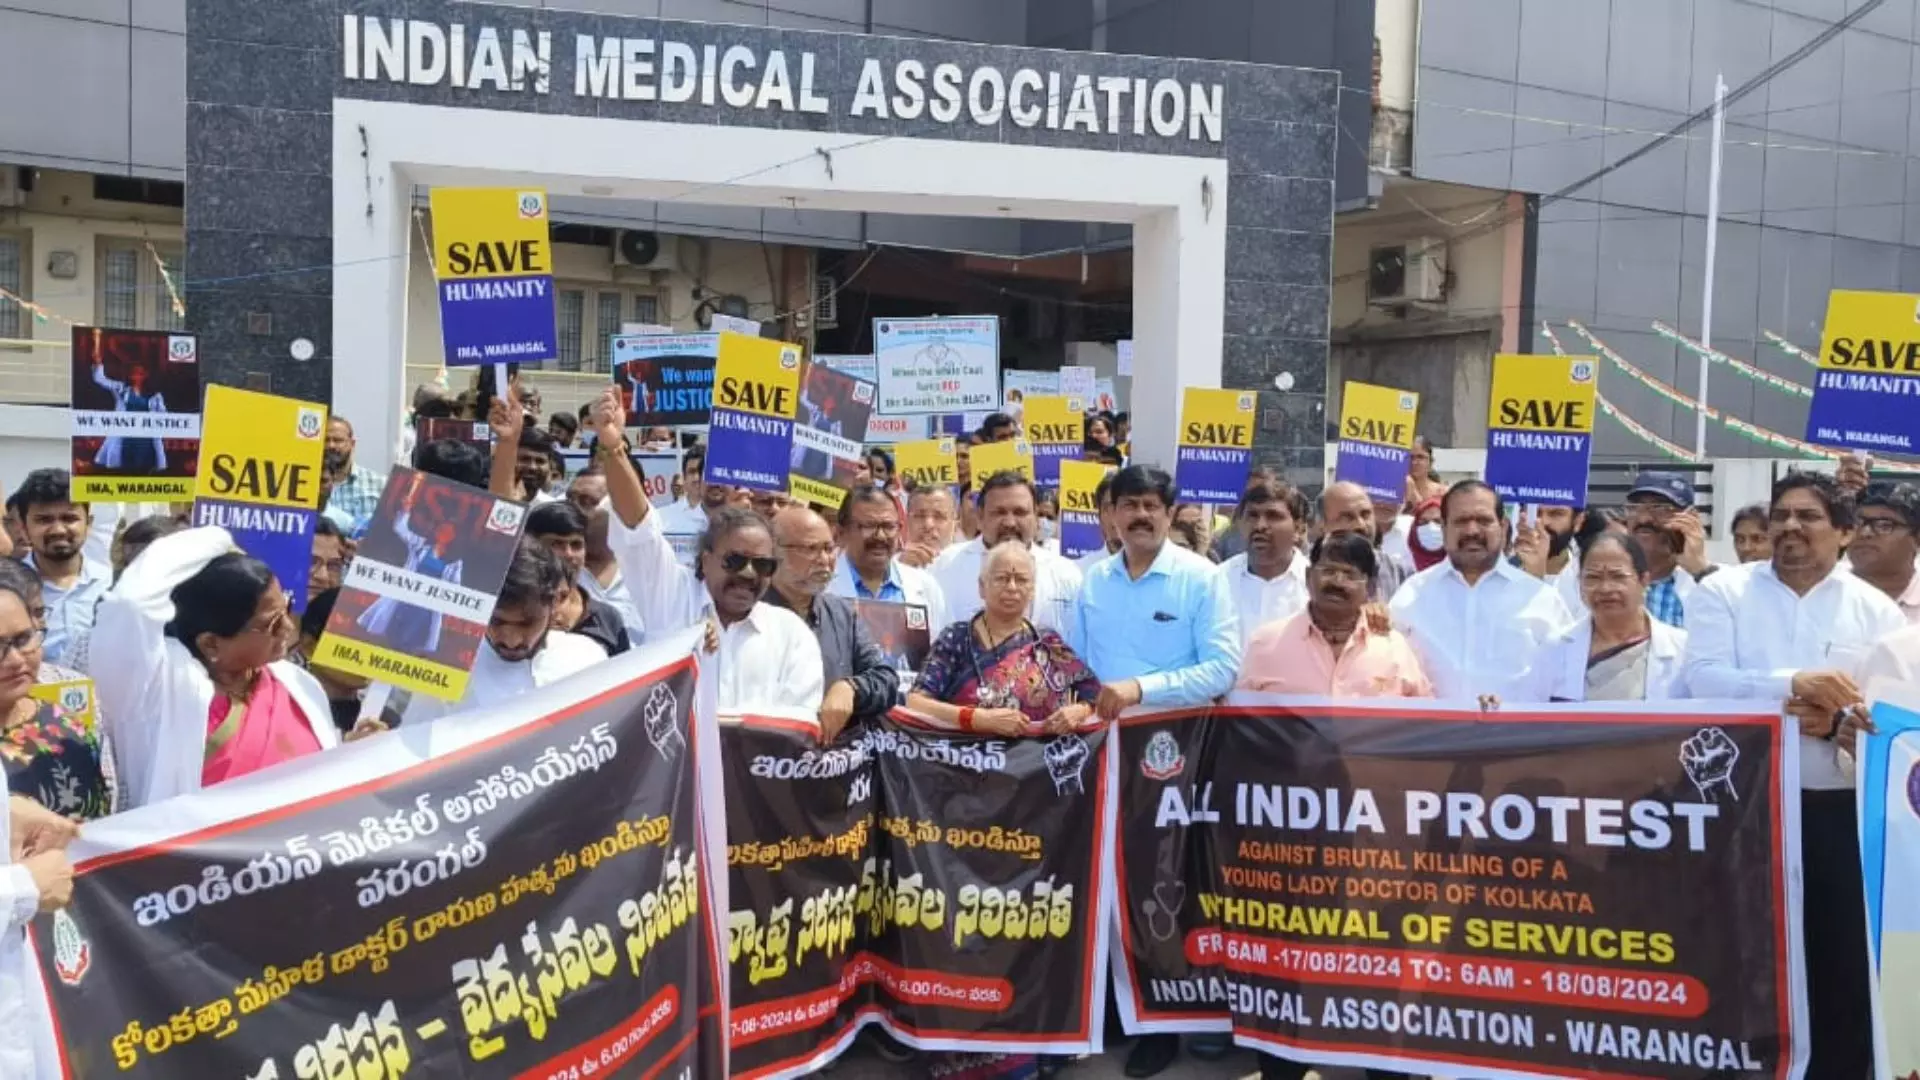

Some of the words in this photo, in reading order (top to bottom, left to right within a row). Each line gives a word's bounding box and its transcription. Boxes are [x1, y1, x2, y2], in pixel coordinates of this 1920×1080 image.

[343, 14, 552, 95] INDIAN
[574, 33, 829, 114] MEDICAL
[850, 58, 1223, 142] ASSOCIATION
[448, 240, 543, 276] SAVE
[445, 279, 546, 301] HUMANITY
[457, 346, 482, 359] IMA,
[484, 341, 547, 356] WARANGAL
[1829, 337, 1920, 371] SAVE
[660, 366, 682, 384] We
[685, 366, 716, 383] wan
[719, 376, 791, 415] SAVE
[76, 416, 95, 426] WE
[100, 416, 137, 428] WANT
[142, 417, 192, 429] JUSTICE
[713, 411, 790, 437] HUMANITY
[1499, 397, 1585, 429] SAVE
[1028, 423, 1078, 441] SAVE
[1187, 421, 1246, 446] SAVE
[1346, 416, 1407, 446] SAVE
[1492, 431, 1585, 452] HUMANITY
[1817, 427, 1842, 442] IMA,
[1845, 430, 1912, 448] WARANGAL
[1180, 448, 1246, 464] HUMANITY
[1338, 440, 1408, 463] HUMANITY
[86, 482, 114, 495] IMA,
[116, 482, 187, 495] WARANGAL
[210, 453, 311, 503] SAVE
[1517, 486, 1576, 501] WARANGAL
[200, 503, 310, 535] HUMANITY
[354, 562, 377, 581] WE
[382, 569, 421, 593] WANT
[426, 581, 486, 610] JUSTICE
[331, 643, 364, 666] IMA,
[368, 652, 450, 689] WARANGAL
[133, 834, 322, 926] ఇండియన్
[319, 793, 440, 868] మెడికల్
[442, 722, 618, 824] అసోసియేషన్
[1235, 783, 1385, 833] INDIA
[1404, 790, 1719, 851] PROTEST
[946, 825, 1042, 860] ఖండిస్తూ
[355, 825, 489, 908] వరంగల్
[1238, 840, 1315, 866] AGAINST
[1323, 847, 1407, 872] BRUTAL
[1413, 851, 1504, 877] KILLING
[1511, 857, 1545, 879] OF
[1551, 858, 1569, 881] A
[1220, 865, 1283, 890] YOUNG
[1287, 873, 1339, 896] LADY
[1345, 878, 1438, 903] DOCTOR
[1445, 883, 1478, 904] OF
[1484, 887, 1596, 914] KOLKATA
[954, 873, 1074, 948] నిలిపివేత
[1401, 913, 1452, 944] OF
[1465, 917, 1676, 963] SERVICES
[111, 998, 239, 1070] కోలకత్తా
[232, 951, 325, 1014] మహిళ
[331, 916, 408, 975] డాక్టర్
[413, 891, 498, 943] దారుణ
[500, 852, 577, 907] హత్యను
[1226, 939, 1268, 963] 6AM
[1408, 958, 1452, 983] TO:
[1460, 962, 1514, 990] 6AM
[1541, 970, 1688, 1005] 18/08/2024
[1320, 995, 1535, 1047] ASSOCIATION
[1565, 1019, 1763, 1072] WARANGAL
